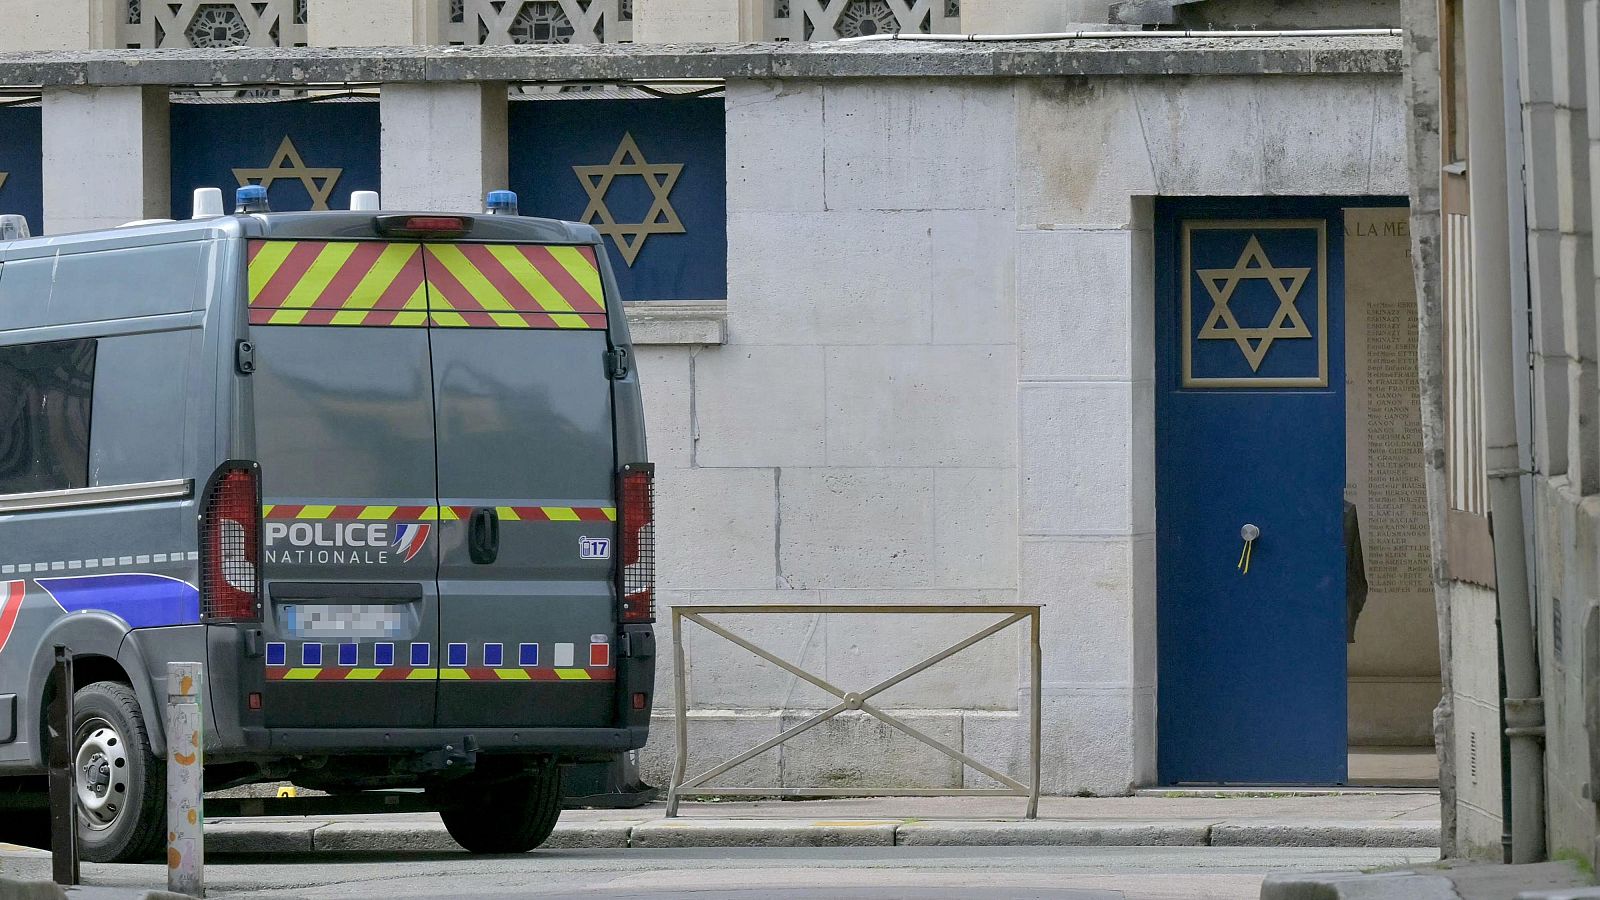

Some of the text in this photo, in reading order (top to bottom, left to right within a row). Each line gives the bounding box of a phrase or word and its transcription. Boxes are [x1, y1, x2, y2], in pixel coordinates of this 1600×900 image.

[1357, 222, 1378, 236] LA
[265, 522, 388, 546] POLICE
[591, 542, 608, 556] 17
[265, 550, 388, 564] NATIONALE
